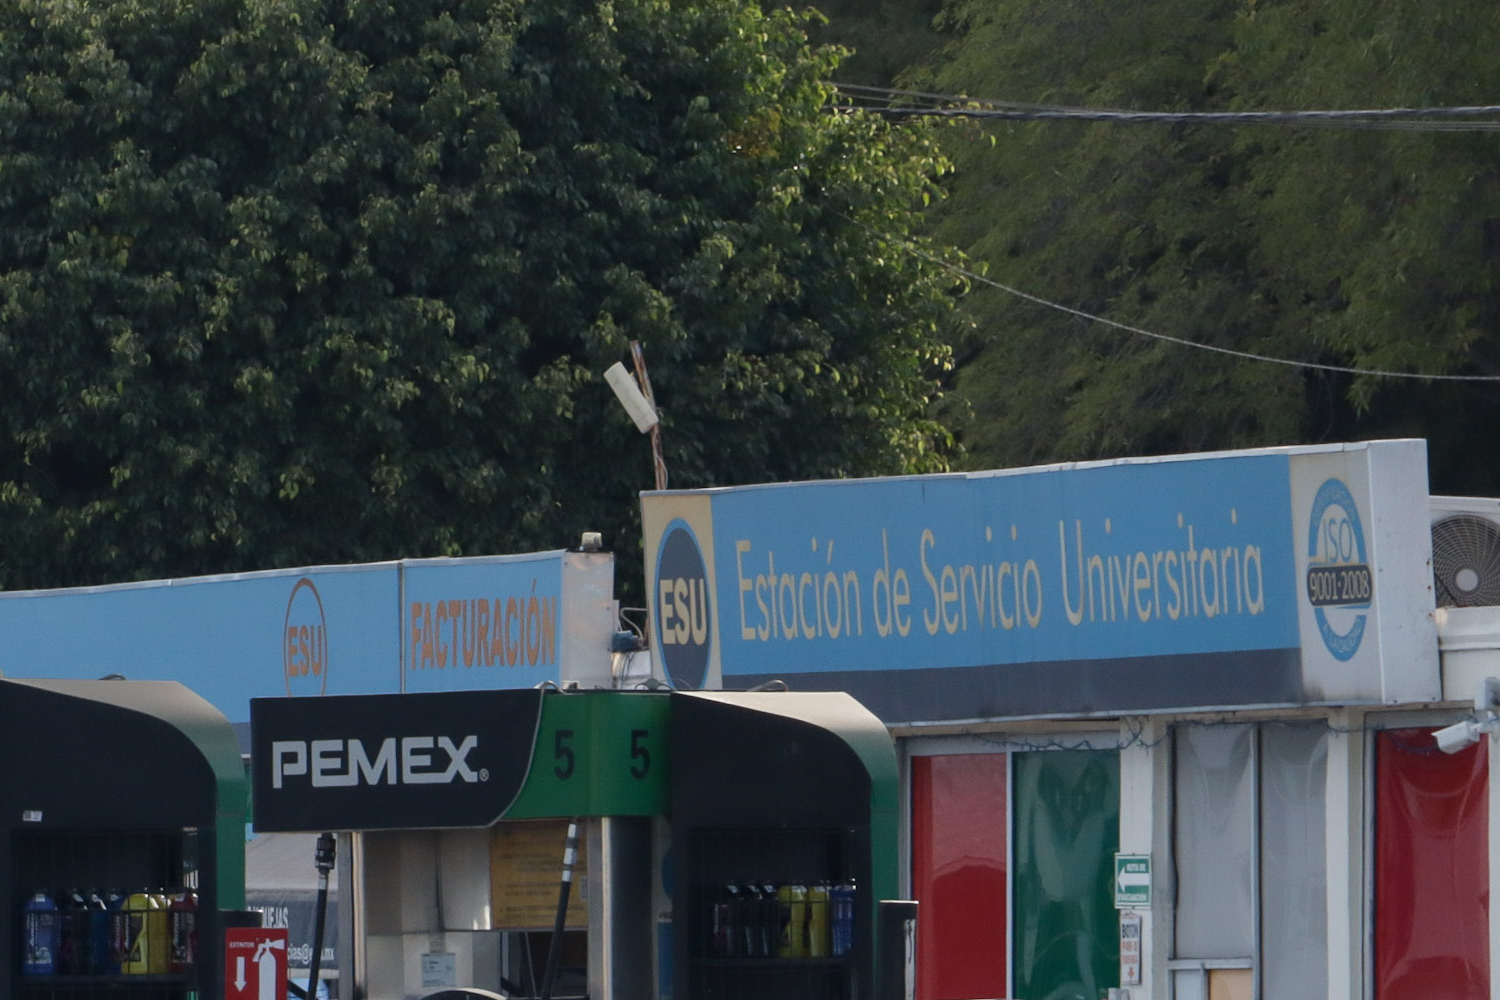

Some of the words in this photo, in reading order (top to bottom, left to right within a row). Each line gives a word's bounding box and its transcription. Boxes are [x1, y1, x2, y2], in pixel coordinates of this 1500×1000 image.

[1322, 517, 1352, 564] ISO
[736, 537, 862, 642] Estación
[873, 527, 912, 638] de
[920, 524, 1042, 635] Servicio
[1059, 508, 1264, 626] Universitaria
[410, 578, 557, 671] FACTURACIÓN
[659, 577, 707, 646] ESU
[287, 625, 322, 677] ESU
[271, 735, 478, 789] PEMEX
[553, 730, 575, 780] 5
[629, 729, 651, 780] 5
